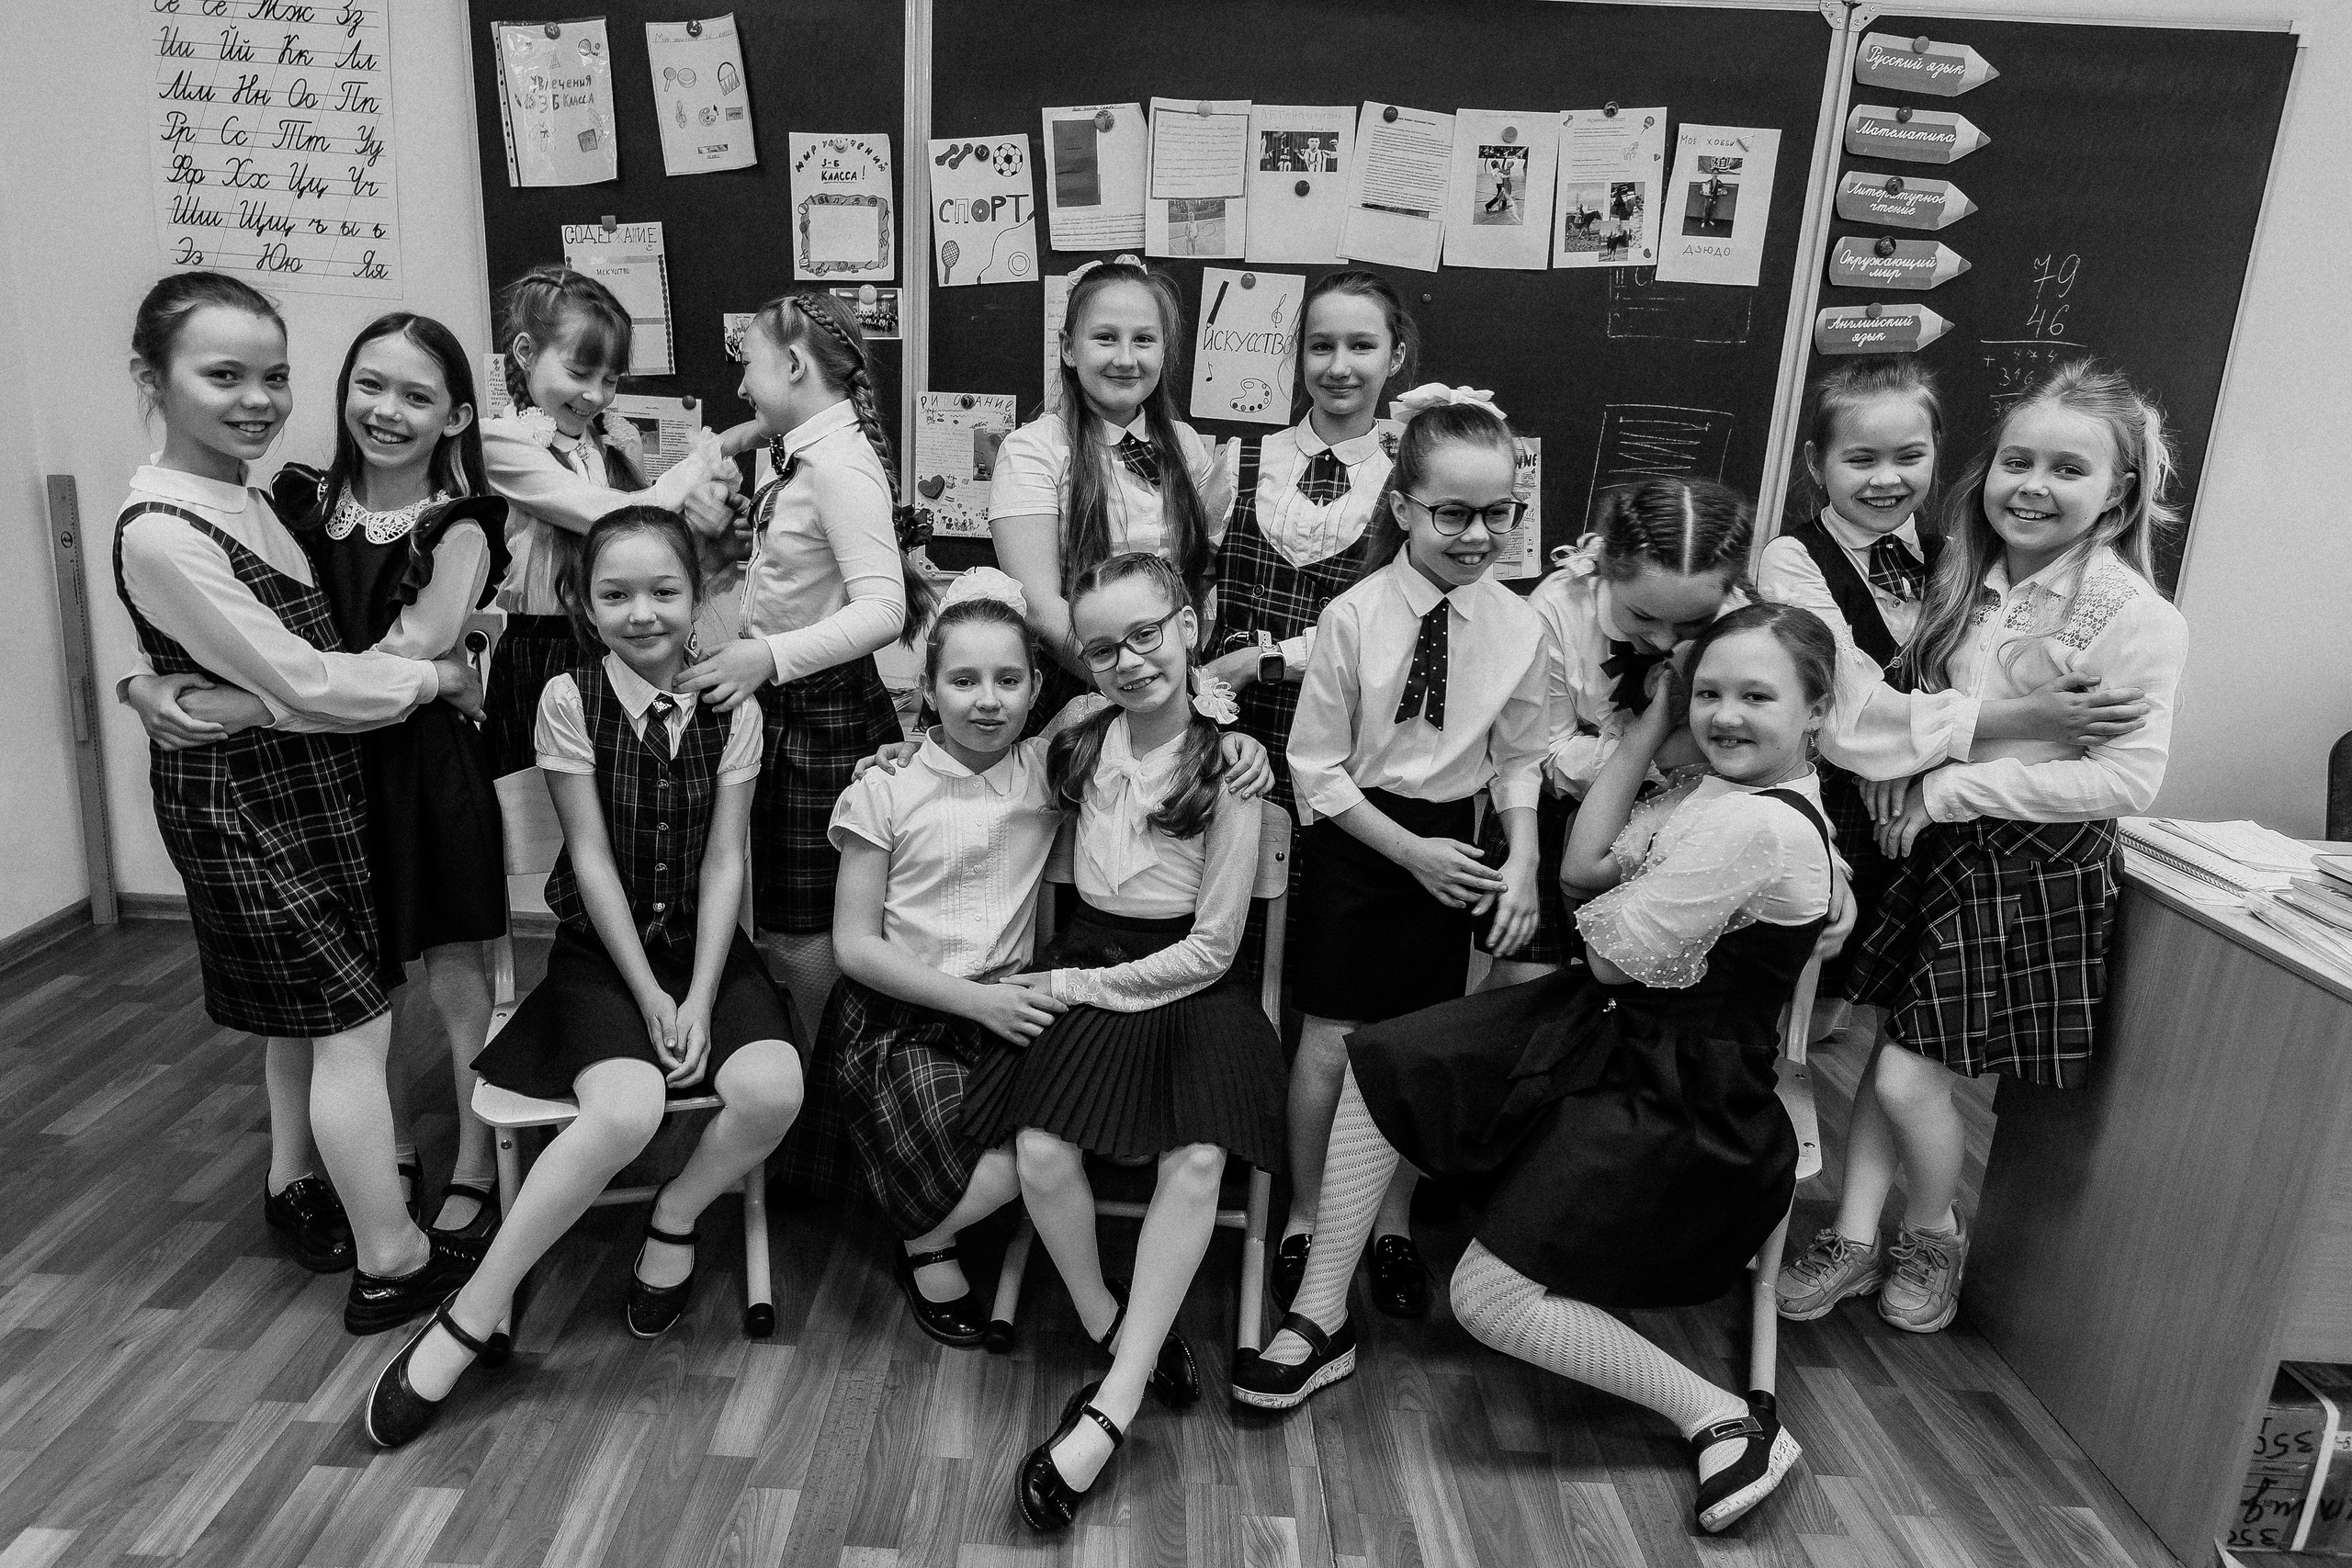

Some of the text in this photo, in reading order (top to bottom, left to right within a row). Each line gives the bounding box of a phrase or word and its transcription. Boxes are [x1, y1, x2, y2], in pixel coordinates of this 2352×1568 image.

[160, 24, 378, 71] Ии Йй Кк Лл
[1865, 46, 1966, 79] Русский язык
[158, 69, 379, 113] Мм Нн Оо Пп
[161, 111, 384, 167] Рр Сс Тт Уу
[1855, 119, 1957, 142] Математика
[166, 154, 379, 199] Фф Хх Цц Чч
[173, 195, 223, 227] Шш
[239, 199, 297, 238] Щщ
[938, 193, 1030, 224] СПОРТ
[1869, 202, 1917, 216] чтение
[175, 236, 390, 280] Ээ Юю Яя
[1681, 244, 1731, 258] ДЗЮДО
[1839, 249, 1938, 272] Окружающий
[1869, 267, 1902, 284] мир
[2033, 254, 2082, 299] 79
[1827, 314, 1914, 331] Английский
[2026, 303, 2070, 339] 46
[1202, 327, 1295, 355] ИСКУССТВО
[1851, 331, 1886, 348] язык
